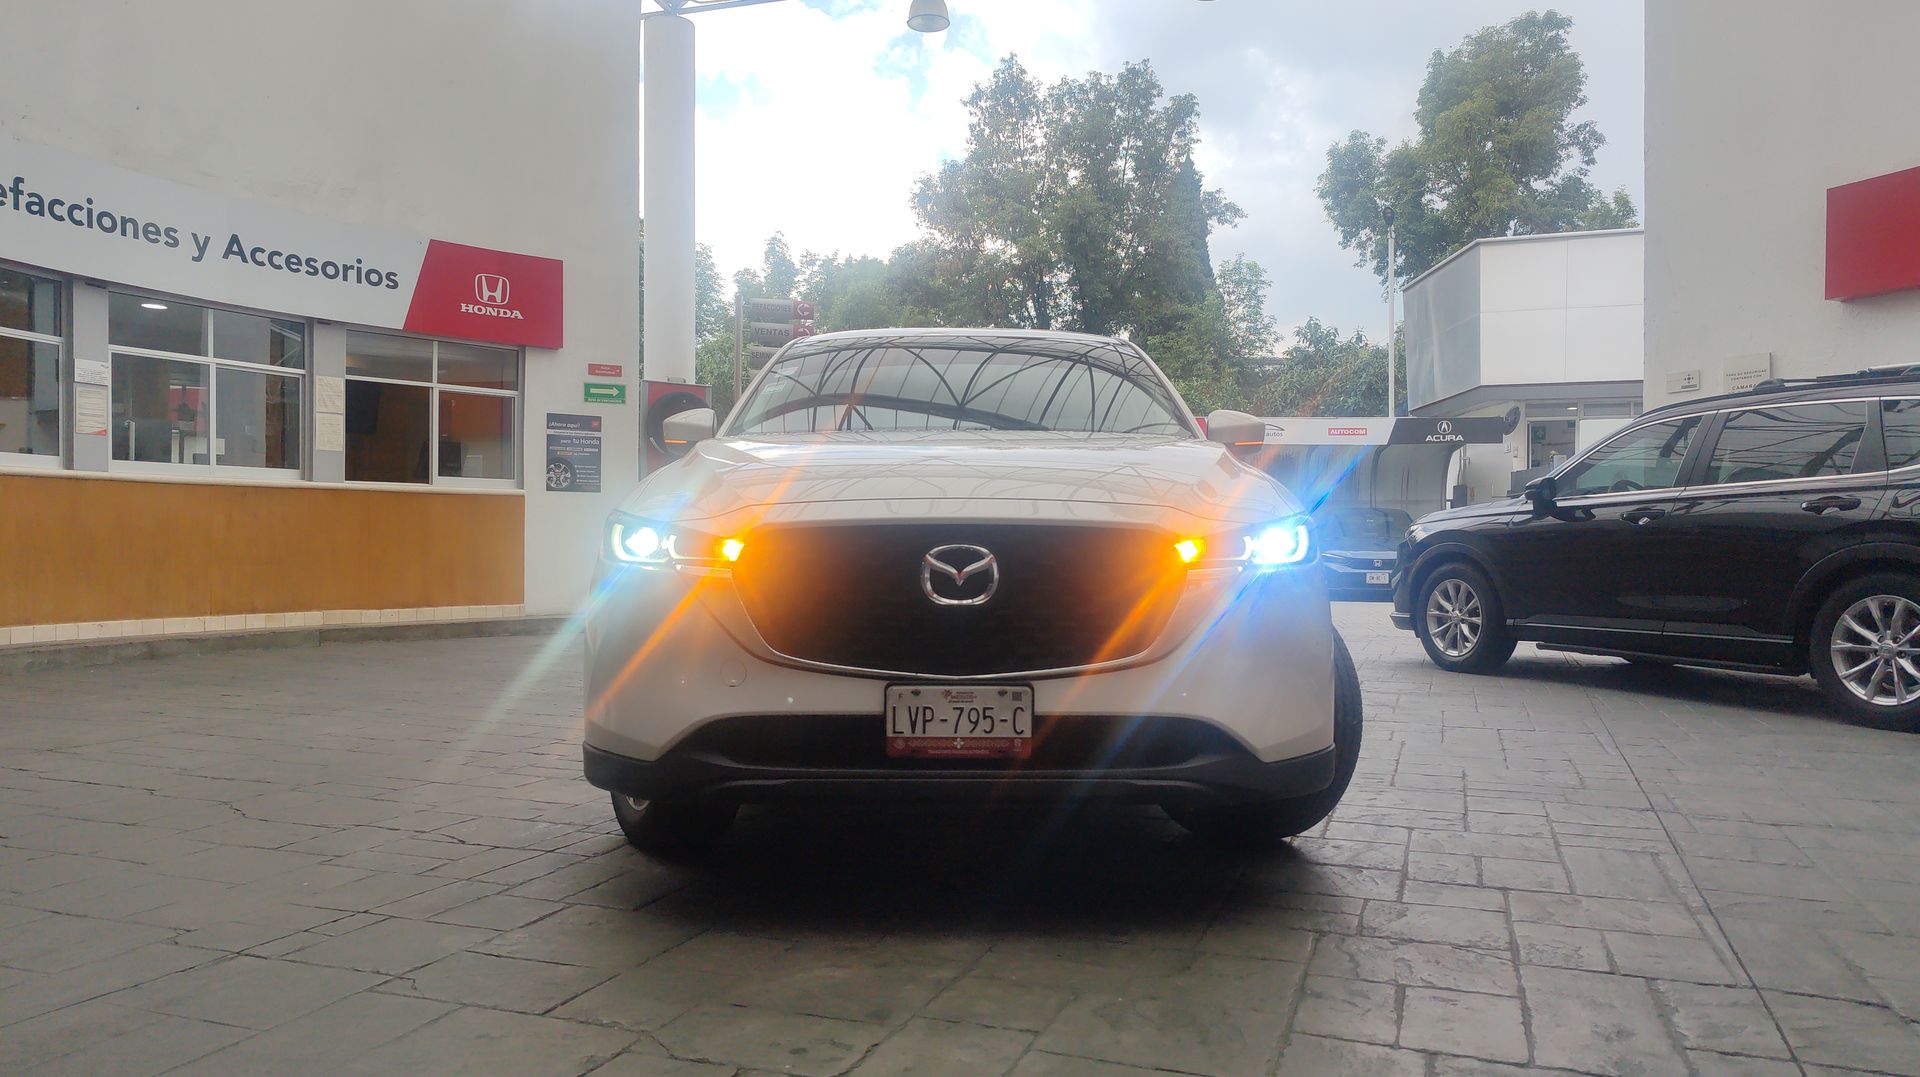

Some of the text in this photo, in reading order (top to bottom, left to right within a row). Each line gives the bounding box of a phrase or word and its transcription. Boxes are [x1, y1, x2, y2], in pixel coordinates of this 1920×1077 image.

[191, 232, 211, 262] y
[222, 234, 399, 291] Accesorios
[460, 303, 524, 320] HONDA
[754, 328, 790, 337] VENTAS
[1425, 434, 1465, 442] ACURA
[892, 706, 1025, 735] LVP-795-C
